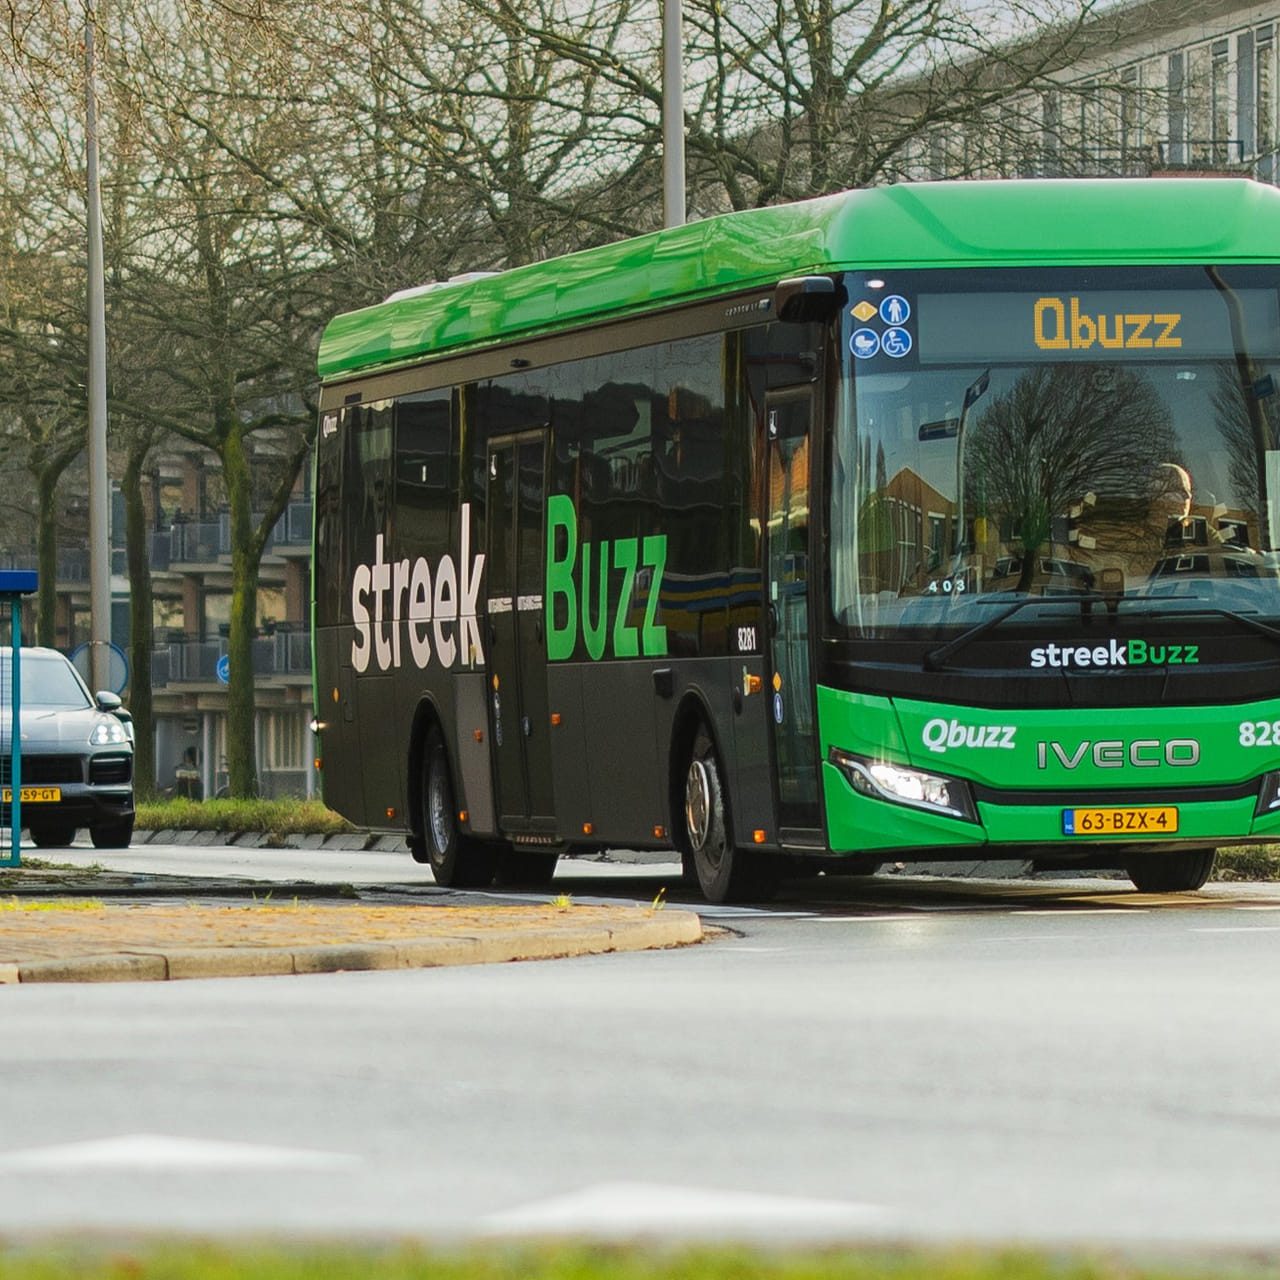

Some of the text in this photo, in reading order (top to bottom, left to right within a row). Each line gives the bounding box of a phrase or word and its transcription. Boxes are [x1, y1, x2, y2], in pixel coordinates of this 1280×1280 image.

[1034, 297, 1182, 349] Qbuzz
[352, 494, 668, 673] streek Buzz
[738, 627, 756, 651] 8281
[1030, 639, 1199, 667] streekBuzz
[922, 718, 1017, 753] Qbuzz
[1037, 738, 1201, 769] IVECO
[1081, 811, 1168, 830] 63-BZX-4
